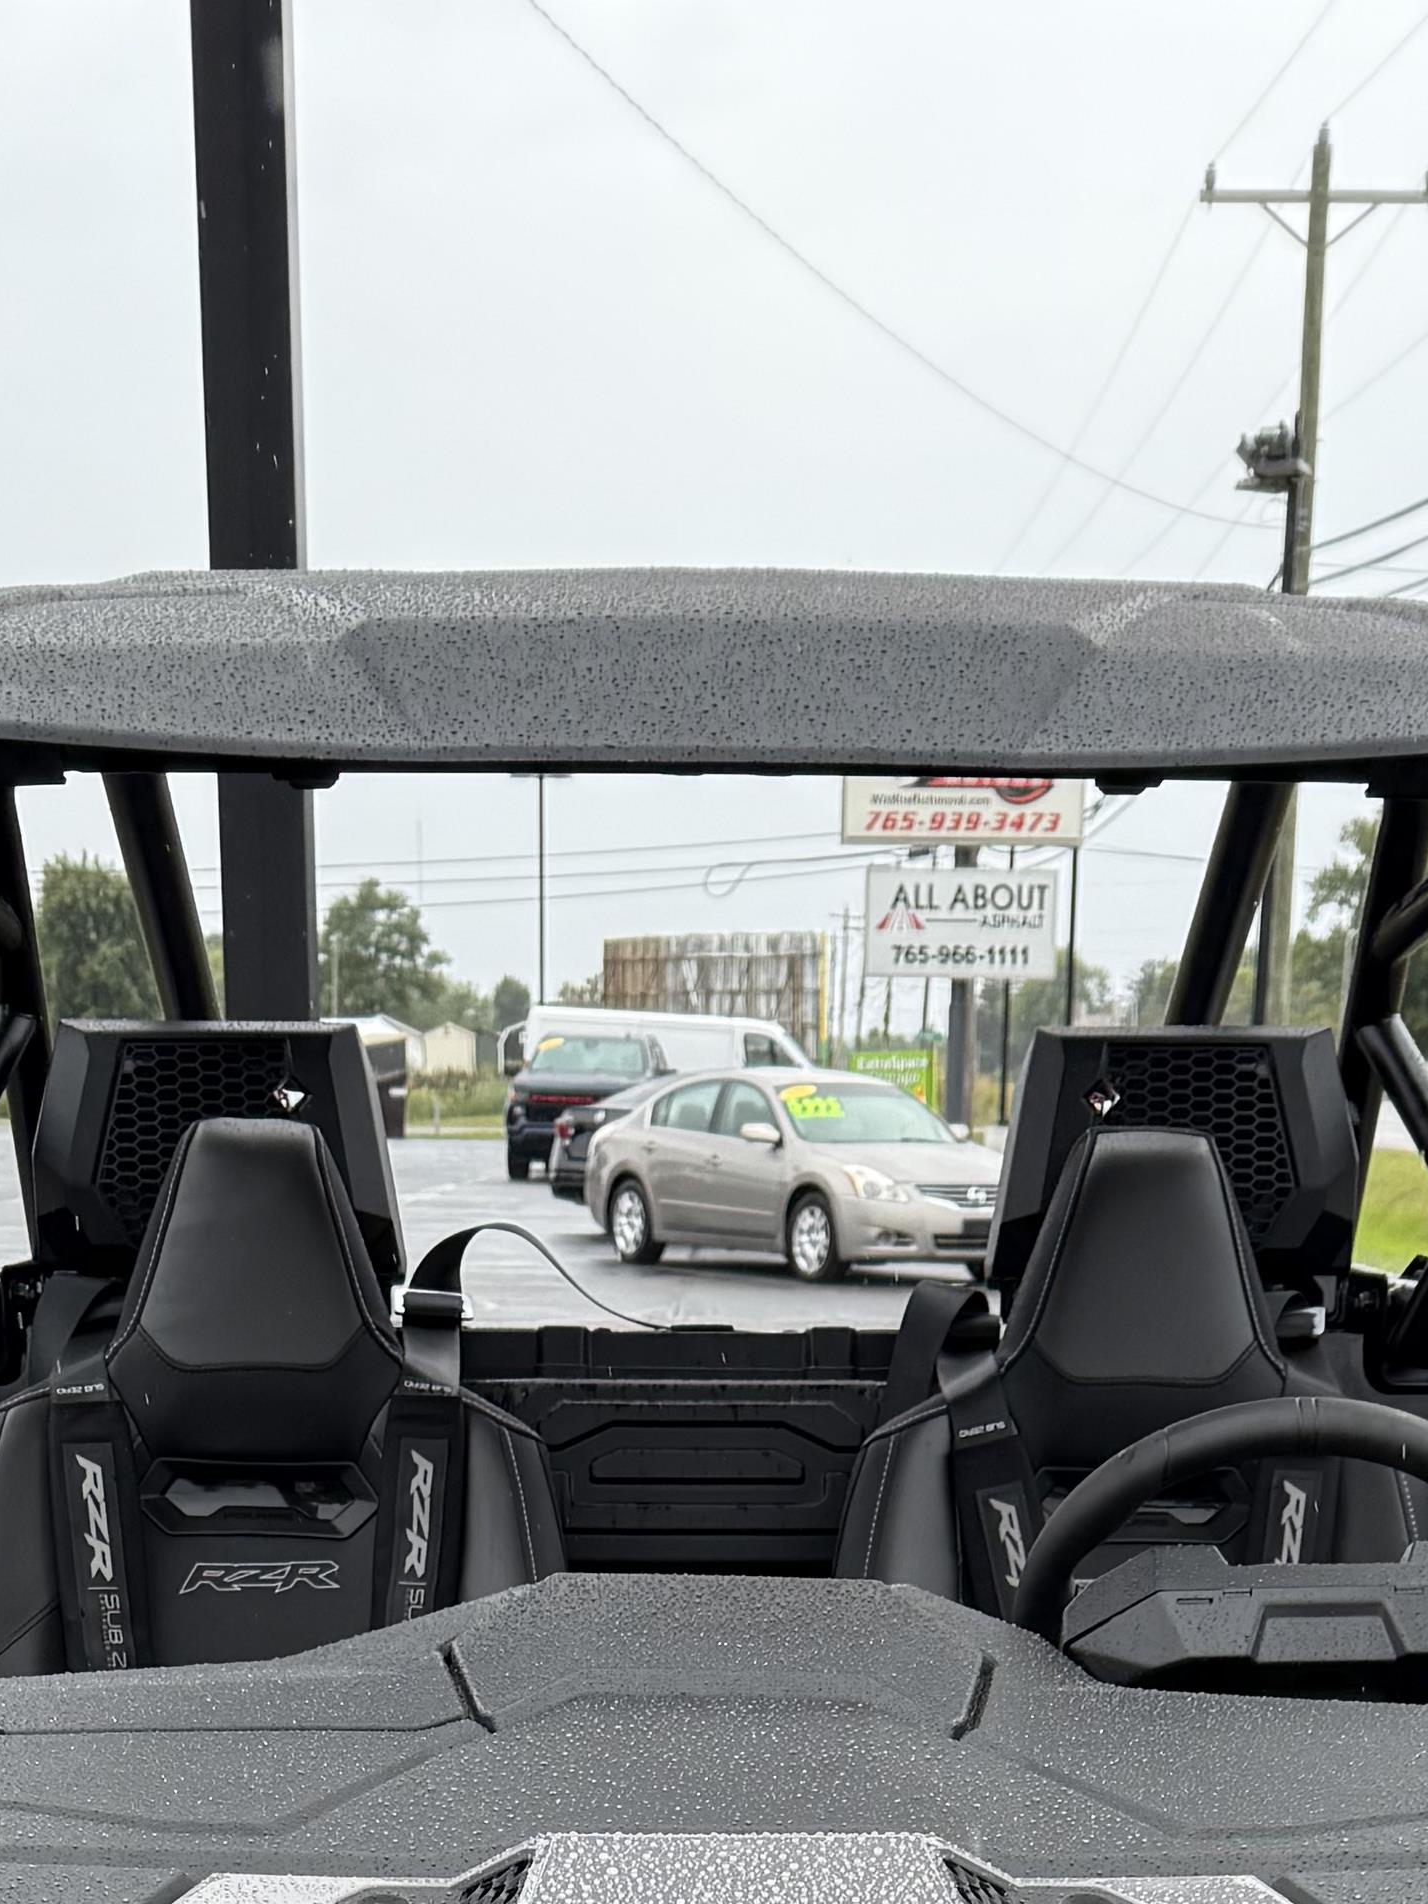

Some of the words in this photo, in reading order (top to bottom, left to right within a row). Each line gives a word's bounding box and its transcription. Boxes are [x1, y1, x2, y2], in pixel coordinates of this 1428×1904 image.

[890, 884, 941, 911] ALL
[951, 884, 1050, 911] ABOUT
[75, 1453, 114, 1582] RZR
[104, 1593, 124, 1645] SUB
[404, 1449, 434, 1578] RZR
[988, 1498, 1026, 1588] RZ
[1274, 1480, 1306, 1565] RZ
[179, 1560, 341, 1595] RZR
